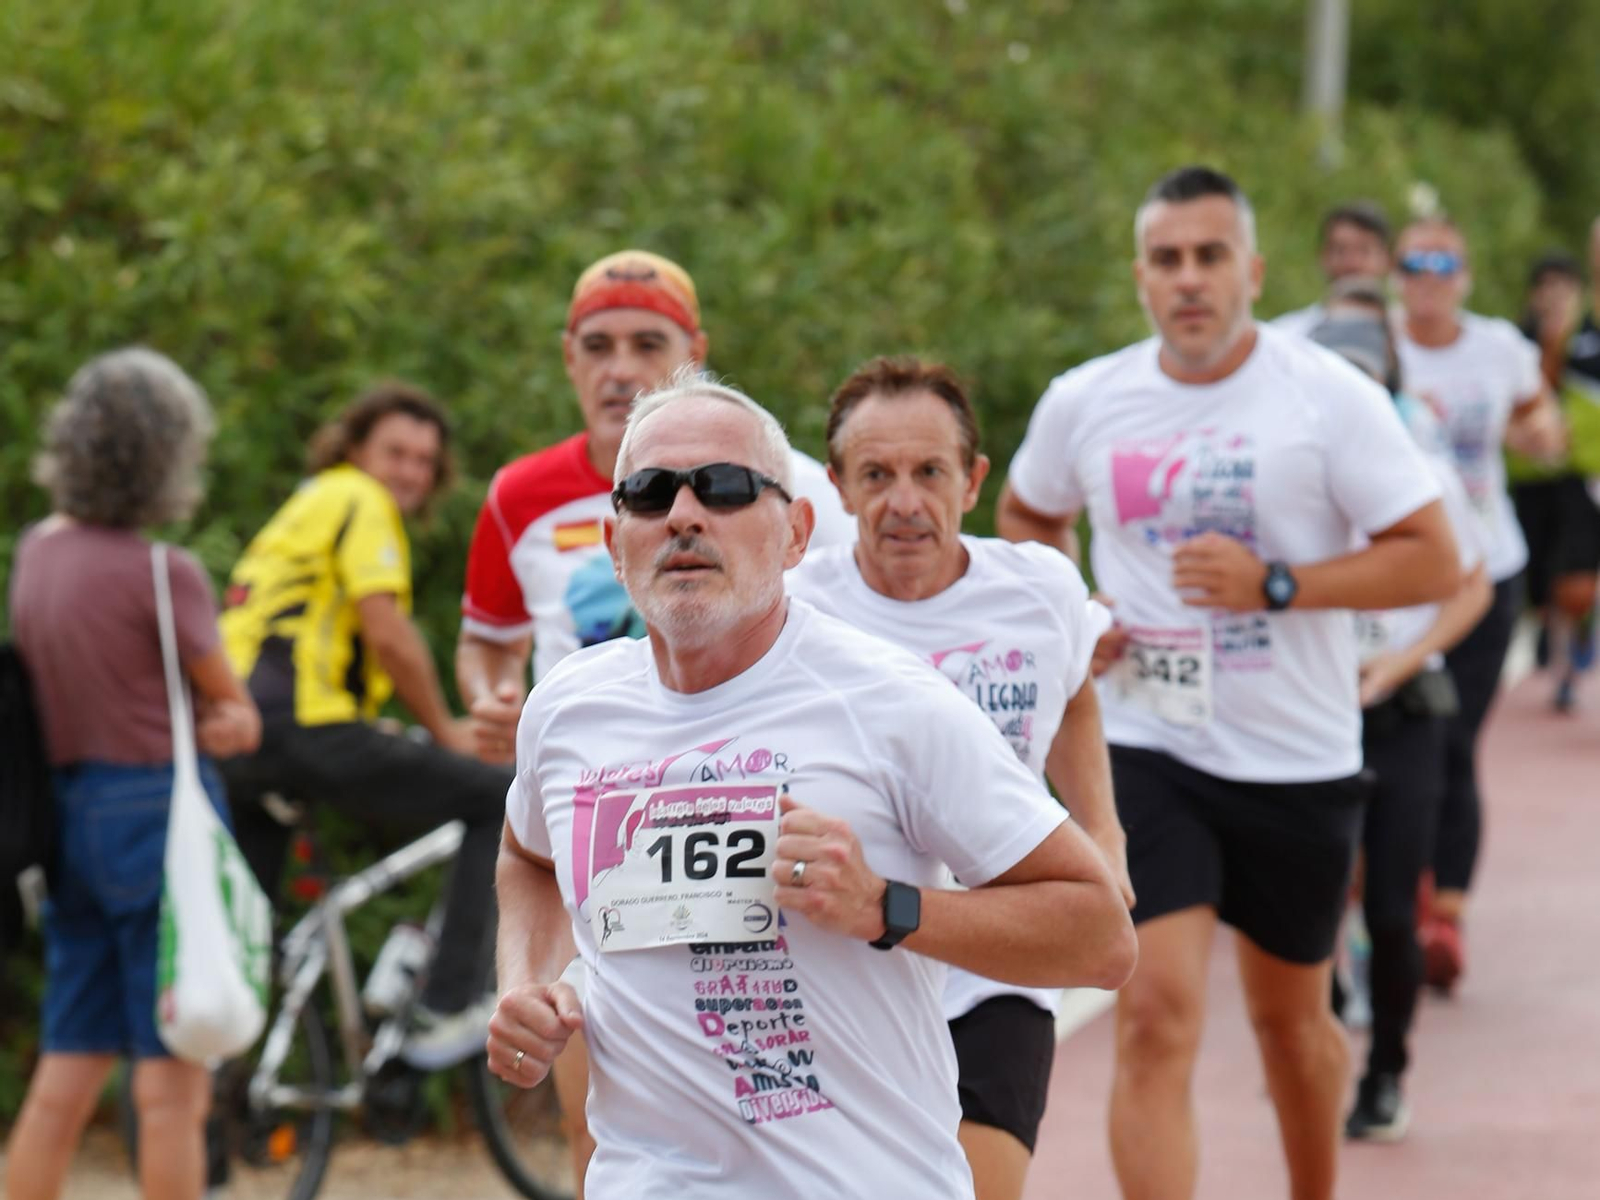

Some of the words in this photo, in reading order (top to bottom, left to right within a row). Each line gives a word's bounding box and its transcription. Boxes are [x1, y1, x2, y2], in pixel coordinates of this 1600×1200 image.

[976, 682, 1038, 712] LEGRIA
[646, 829, 766, 883] 162
[697, 1012, 806, 1038] Deporte
